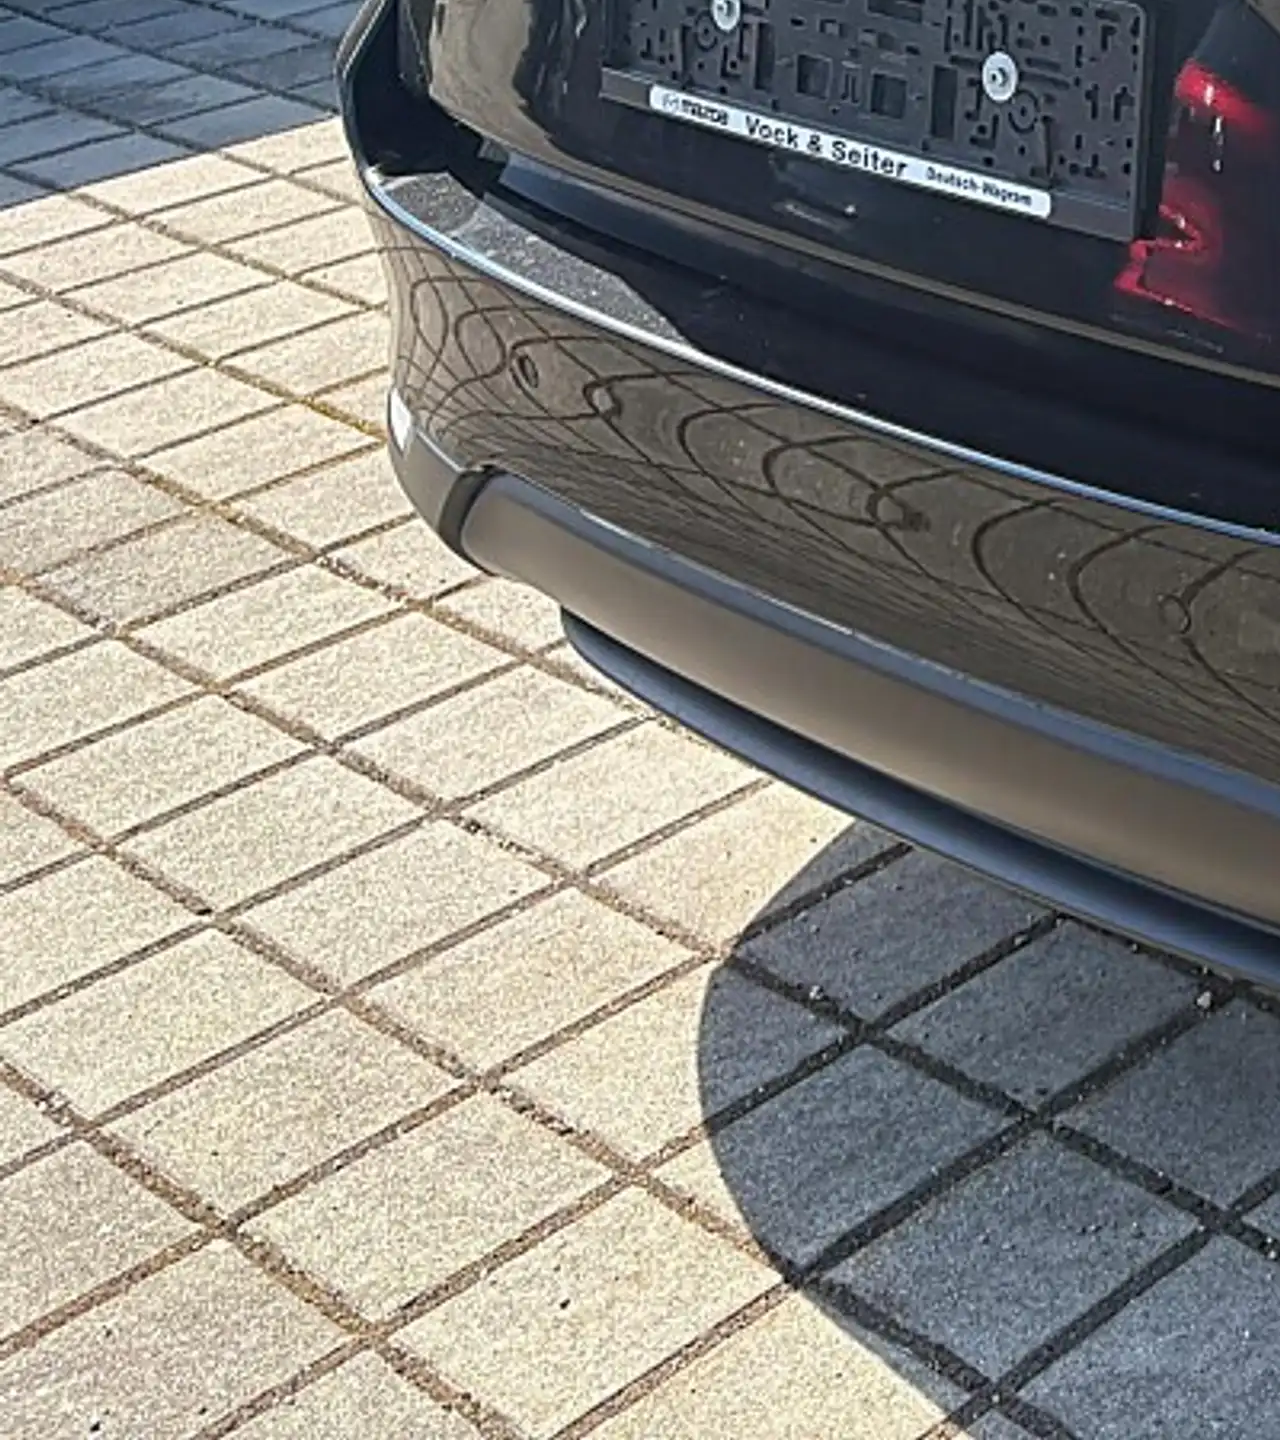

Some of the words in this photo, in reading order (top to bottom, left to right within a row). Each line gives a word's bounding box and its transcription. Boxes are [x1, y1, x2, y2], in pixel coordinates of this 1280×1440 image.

[745, 115, 799, 149] Vock
[807, 133, 823, 153] &
[831, 140, 908, 178] Seiter
